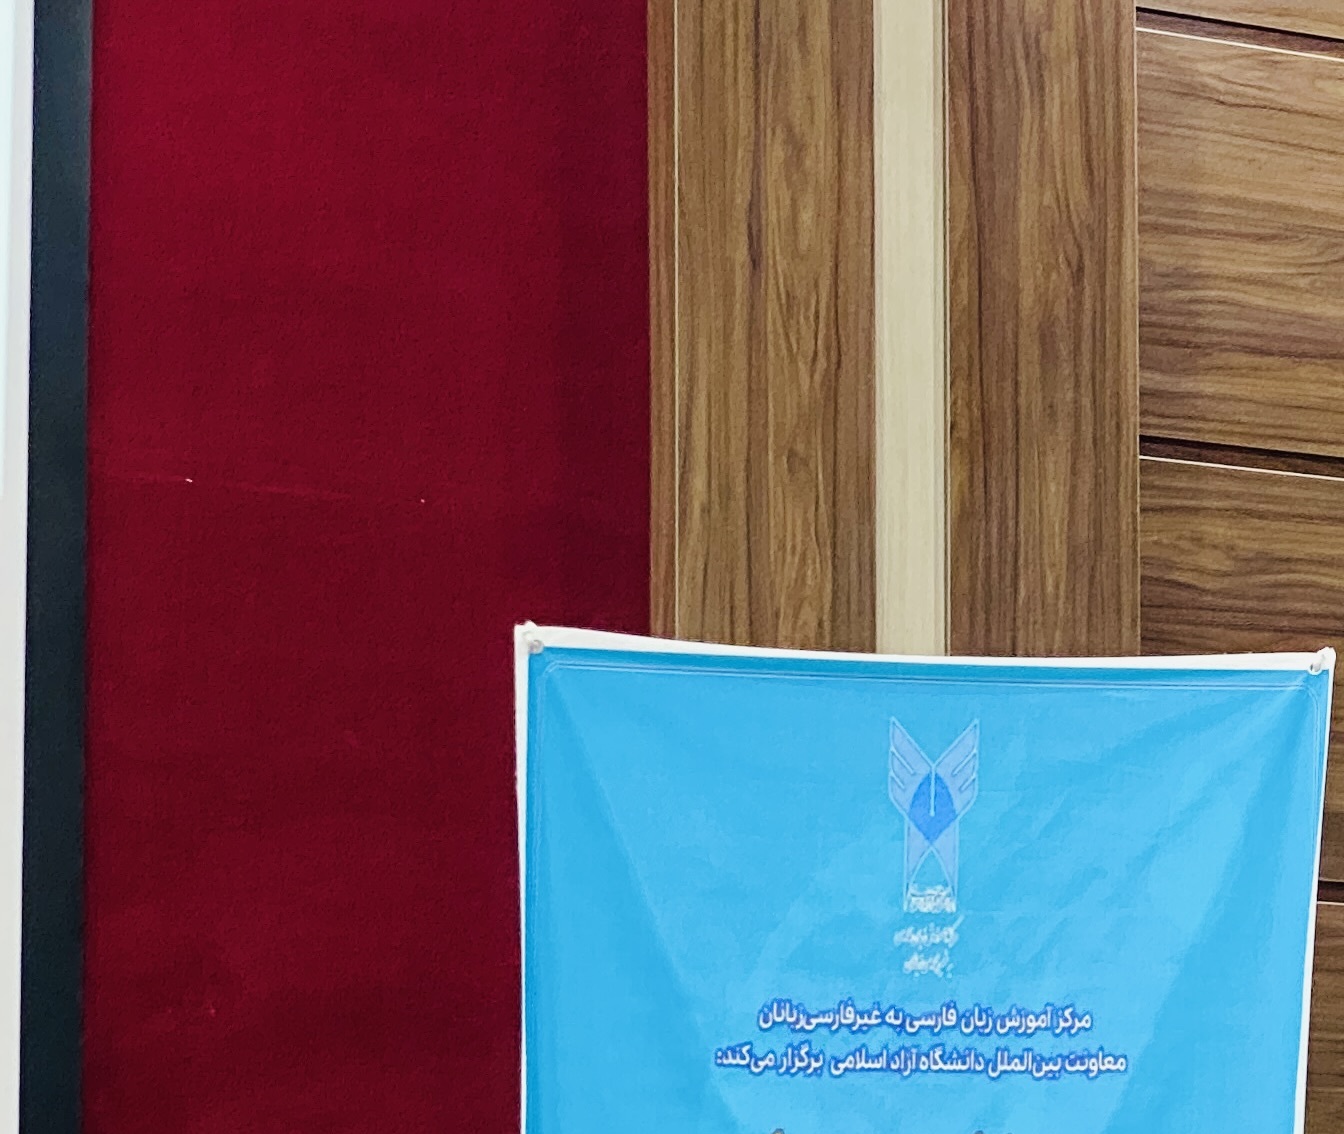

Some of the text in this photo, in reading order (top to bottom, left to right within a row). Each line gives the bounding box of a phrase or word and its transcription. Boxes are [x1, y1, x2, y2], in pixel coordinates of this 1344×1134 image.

[885, 1006, 903, 1036] به
[905, 1001, 957, 1034] فارسی
[960, 1005, 993, 1034] زبان
[996, 1003, 1052, 1035] آموزش
[1055, 1006, 1092, 1035] مرکز
[779, 1043, 823, 1078] برگزار
[830, 1047, 888, 1075] اسلامی
[890, 1047, 917, 1076] آزاد
[919, 1045, 985, 1071] دانشگاه
[1064, 1049, 1127, 1077] معاونت
